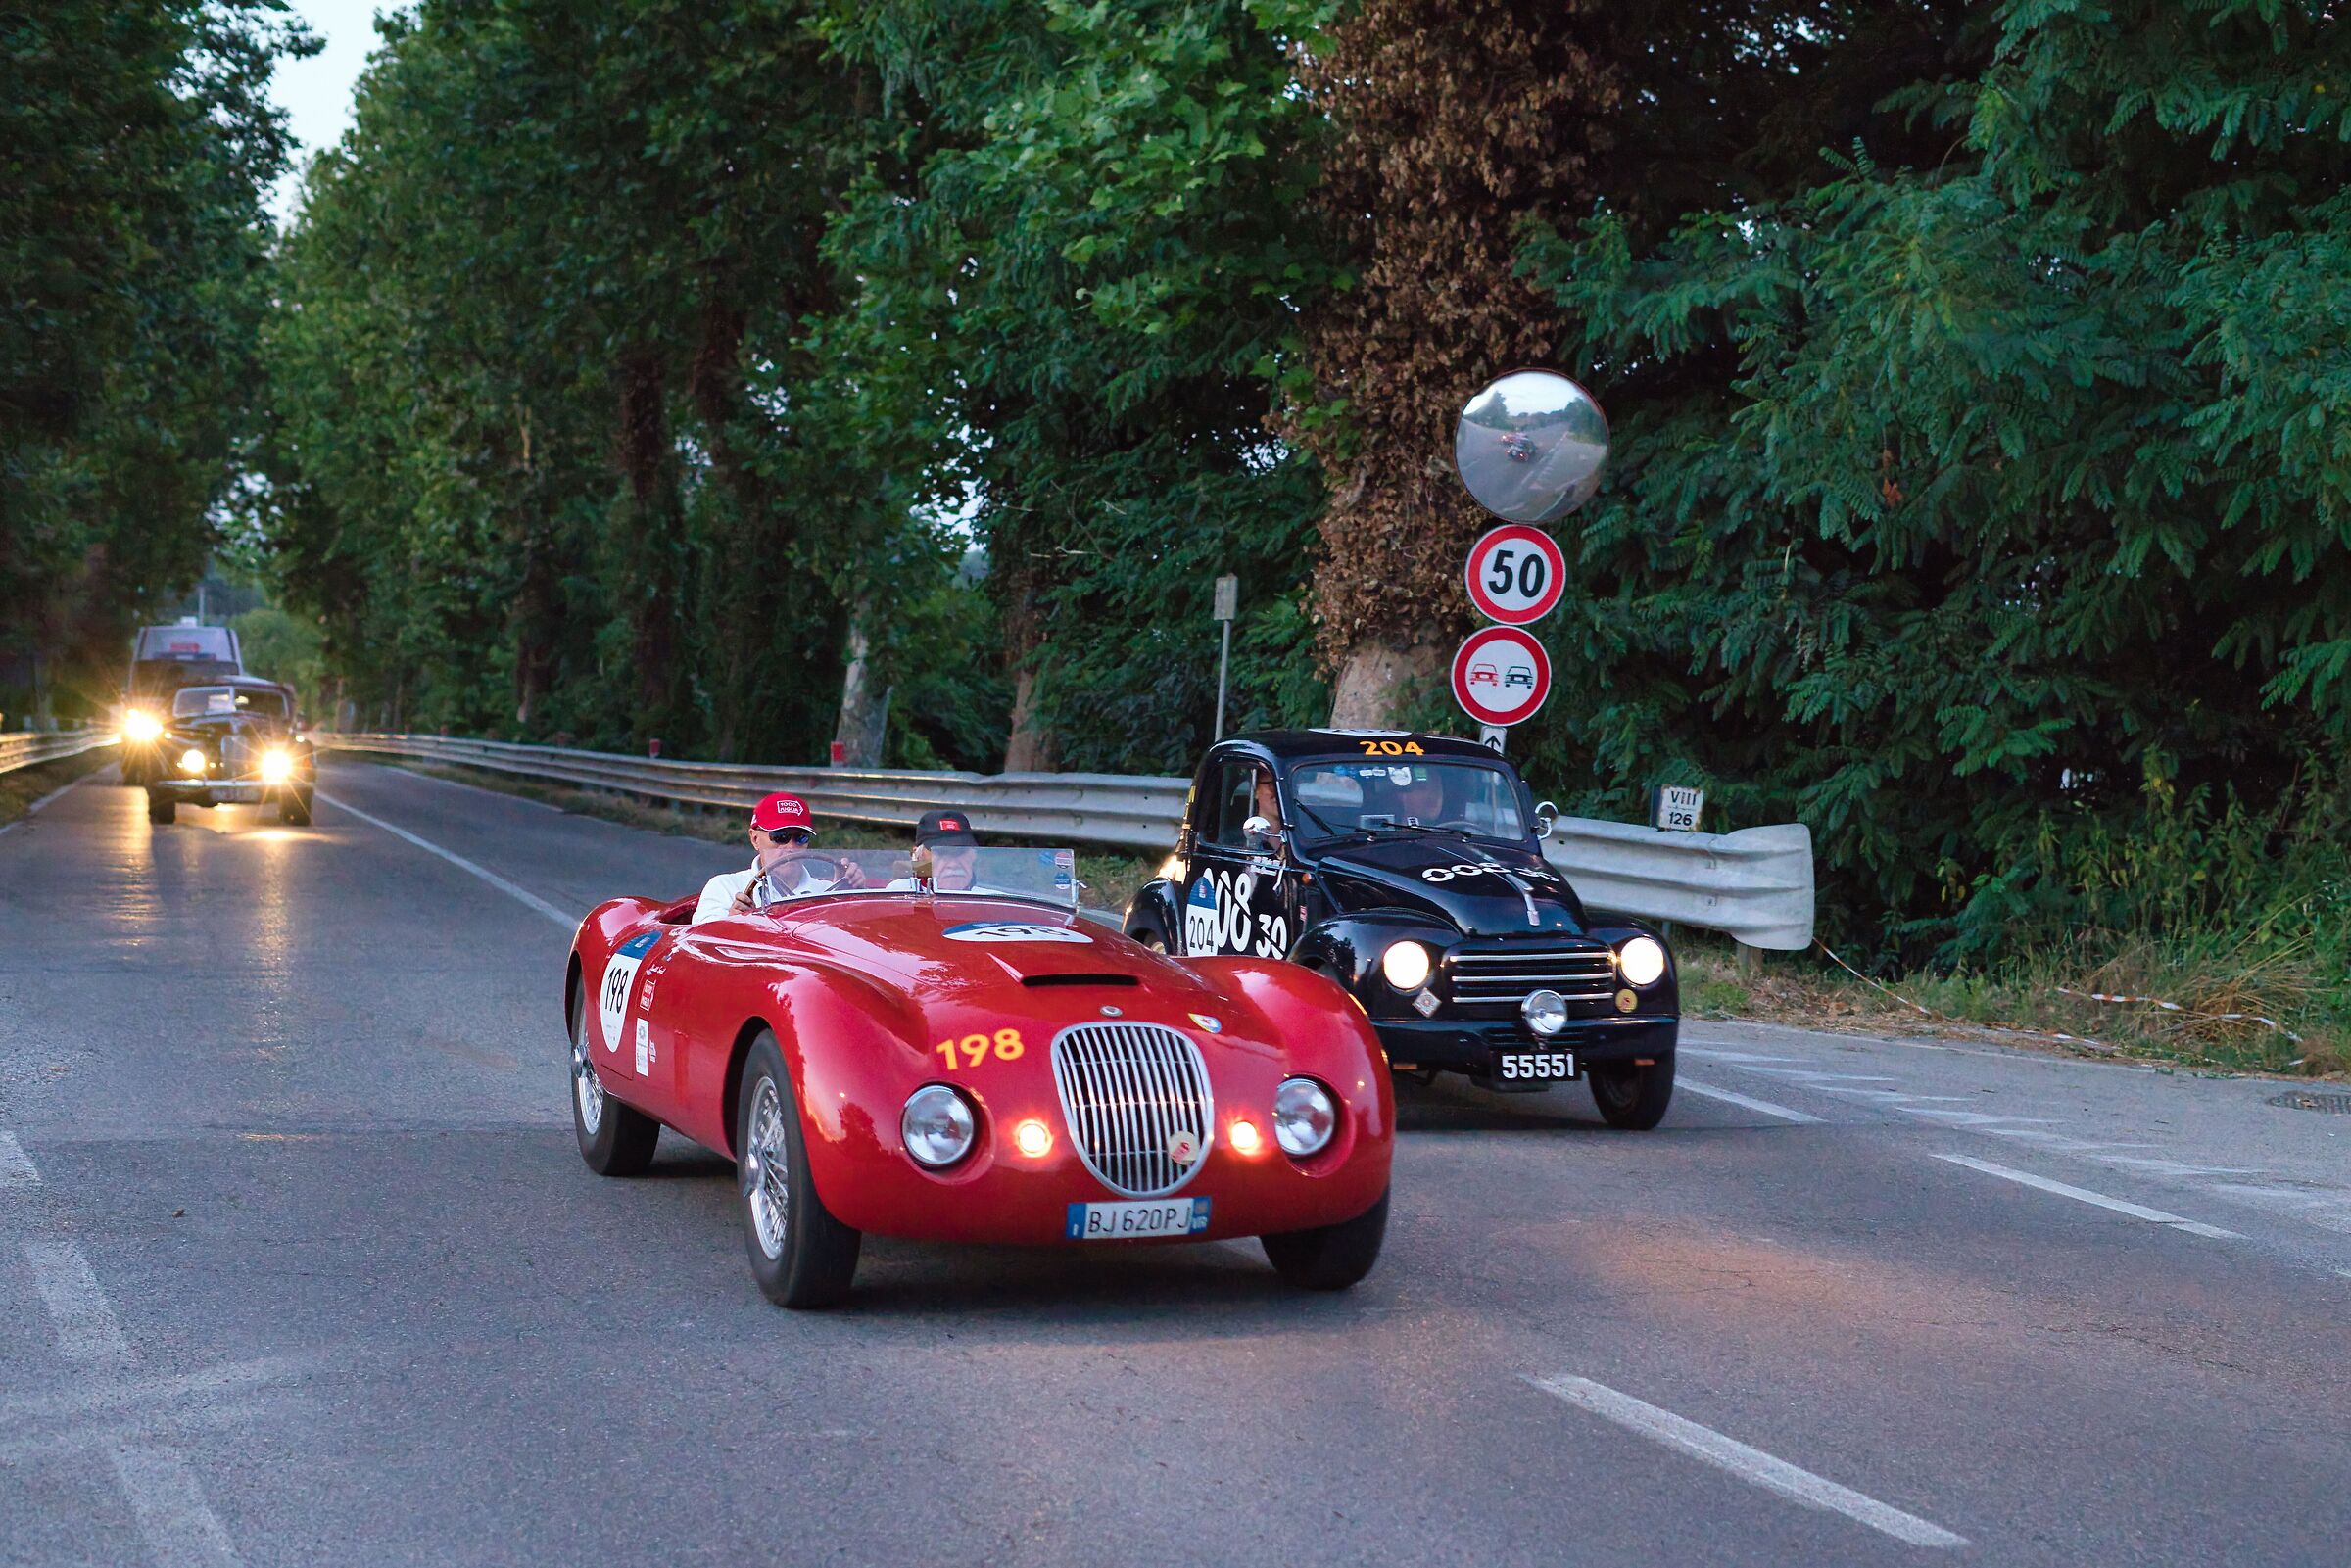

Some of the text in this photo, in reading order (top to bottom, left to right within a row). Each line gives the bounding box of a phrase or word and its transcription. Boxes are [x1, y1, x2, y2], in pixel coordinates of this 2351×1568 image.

[1488, 549, 1545, 598] 50
[1359, 740, 1427, 756] 204
[1670, 790, 1697, 806] VIII
[1669, 812, 1693, 826] 126
[1202, 867, 1288, 961] 08 30
[1189, 915, 1215, 953] 204
[604, 966, 630, 1015] 198
[936, 1028, 1025, 1070] 198
[1501, 1053, 1575, 1079] 55551
